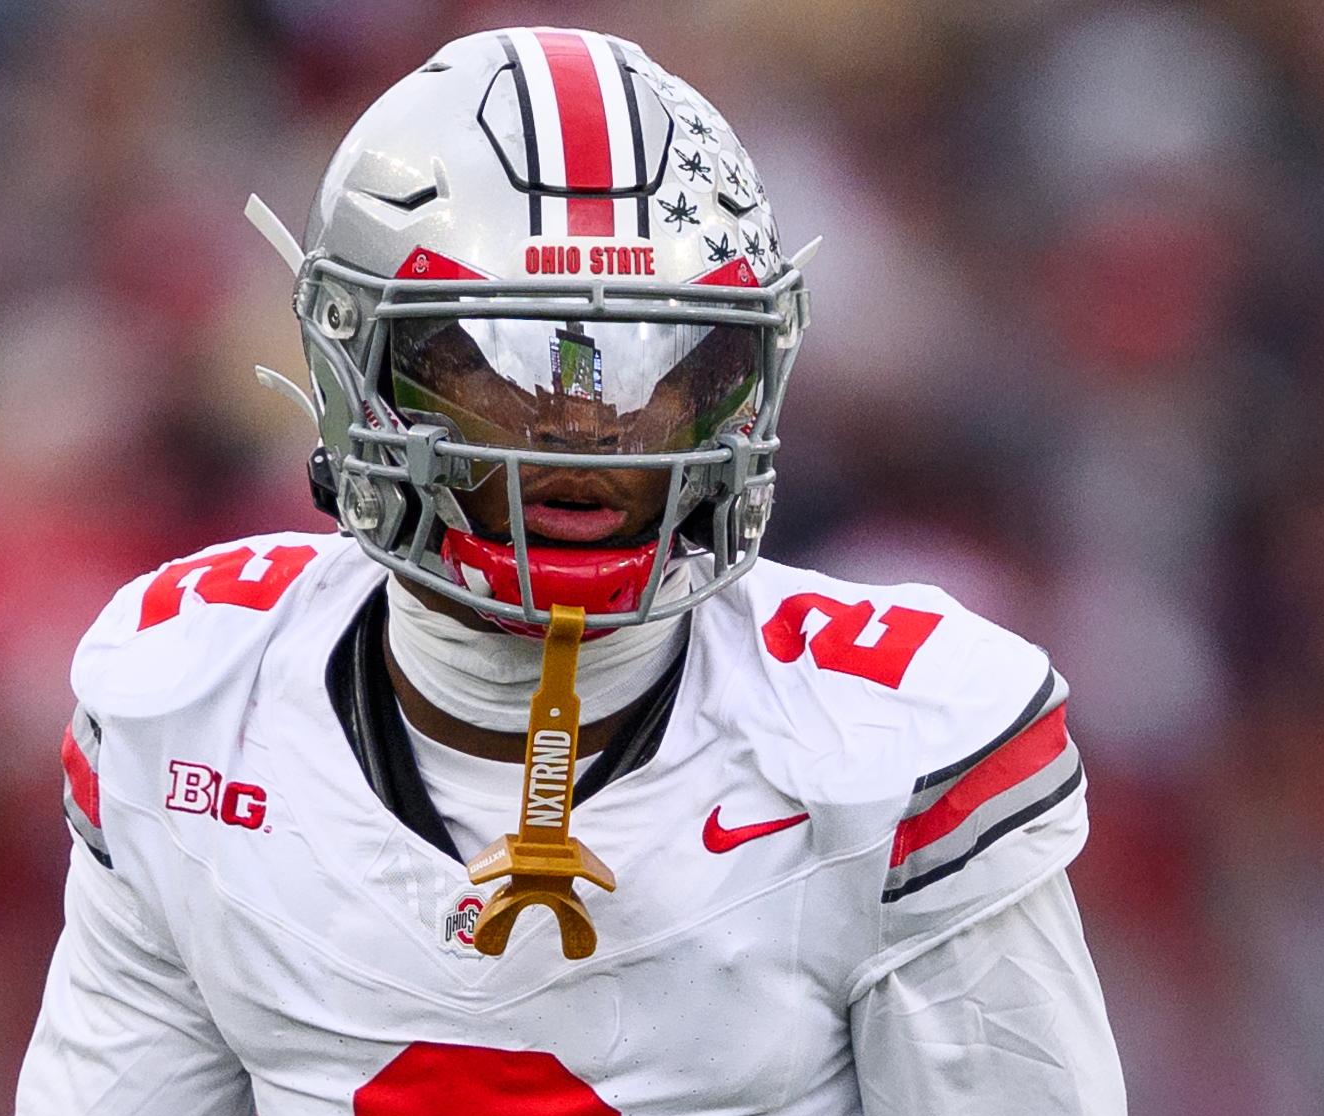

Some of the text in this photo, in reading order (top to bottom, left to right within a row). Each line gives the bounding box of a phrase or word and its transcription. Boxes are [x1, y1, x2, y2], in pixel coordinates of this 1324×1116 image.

[525, 246, 656, 276] OHIO STATE
[137, 545, 318, 632] 2
[761, 593, 944, 690] 2
[526, 730, 571, 827] NXTRND
[445, 912, 468, 942] OHIO
